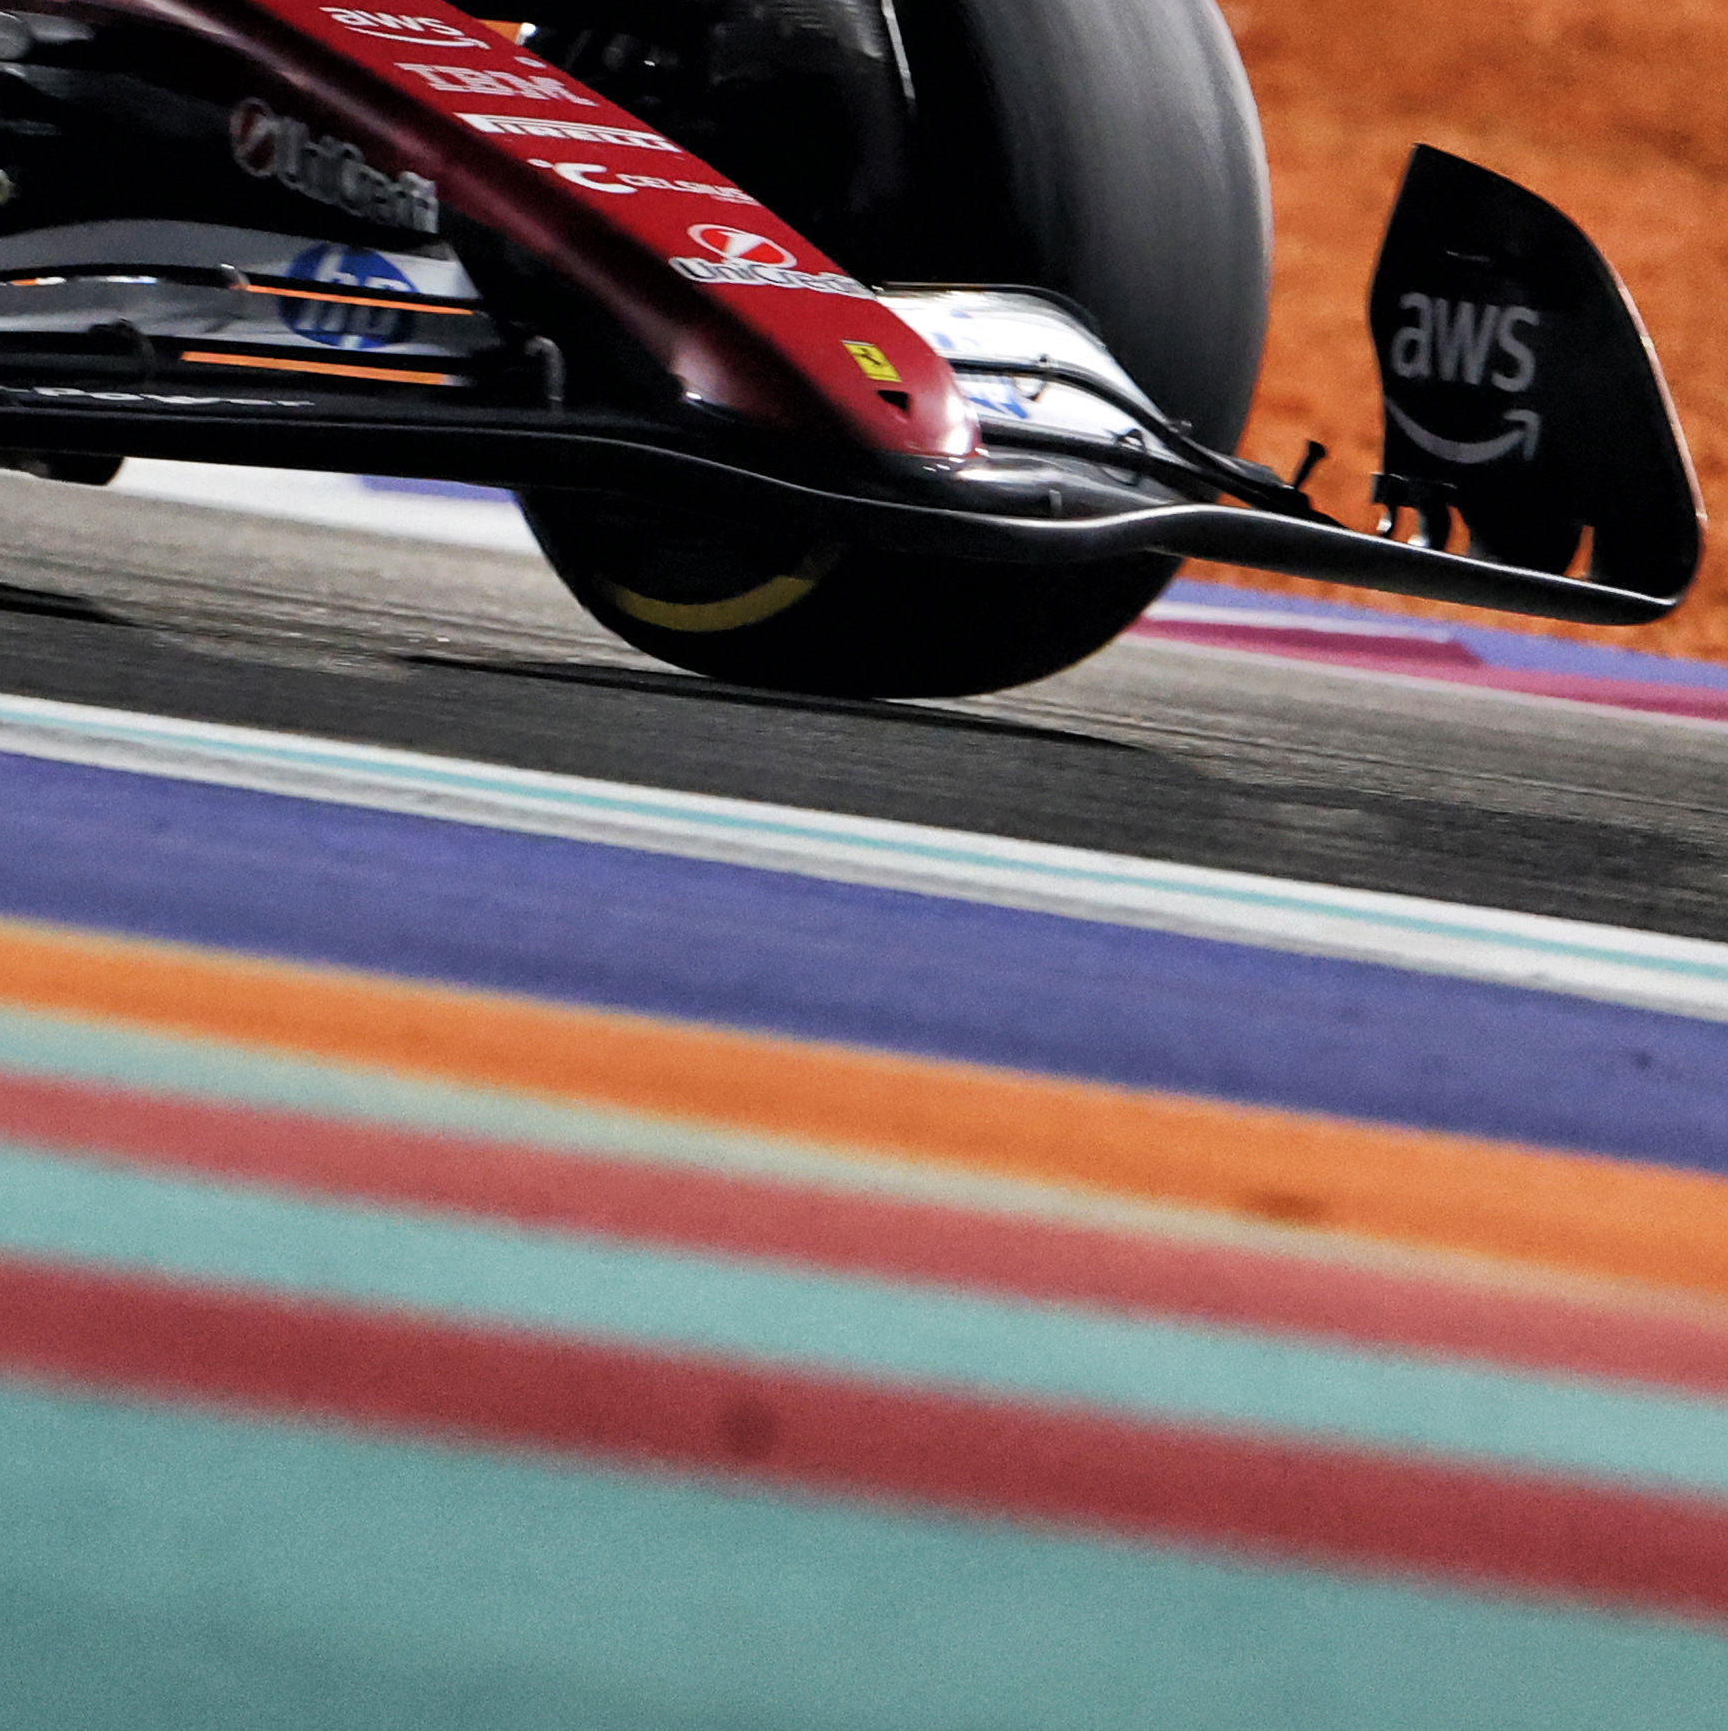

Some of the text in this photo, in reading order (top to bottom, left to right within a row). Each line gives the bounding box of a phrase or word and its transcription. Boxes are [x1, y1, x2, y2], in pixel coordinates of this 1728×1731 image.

[319, 5, 466, 39] aws
[393, 61, 600, 108] IBM
[453, 110, 684, 154] PIRELLI
[1391, 291, 1542, 394] aws
